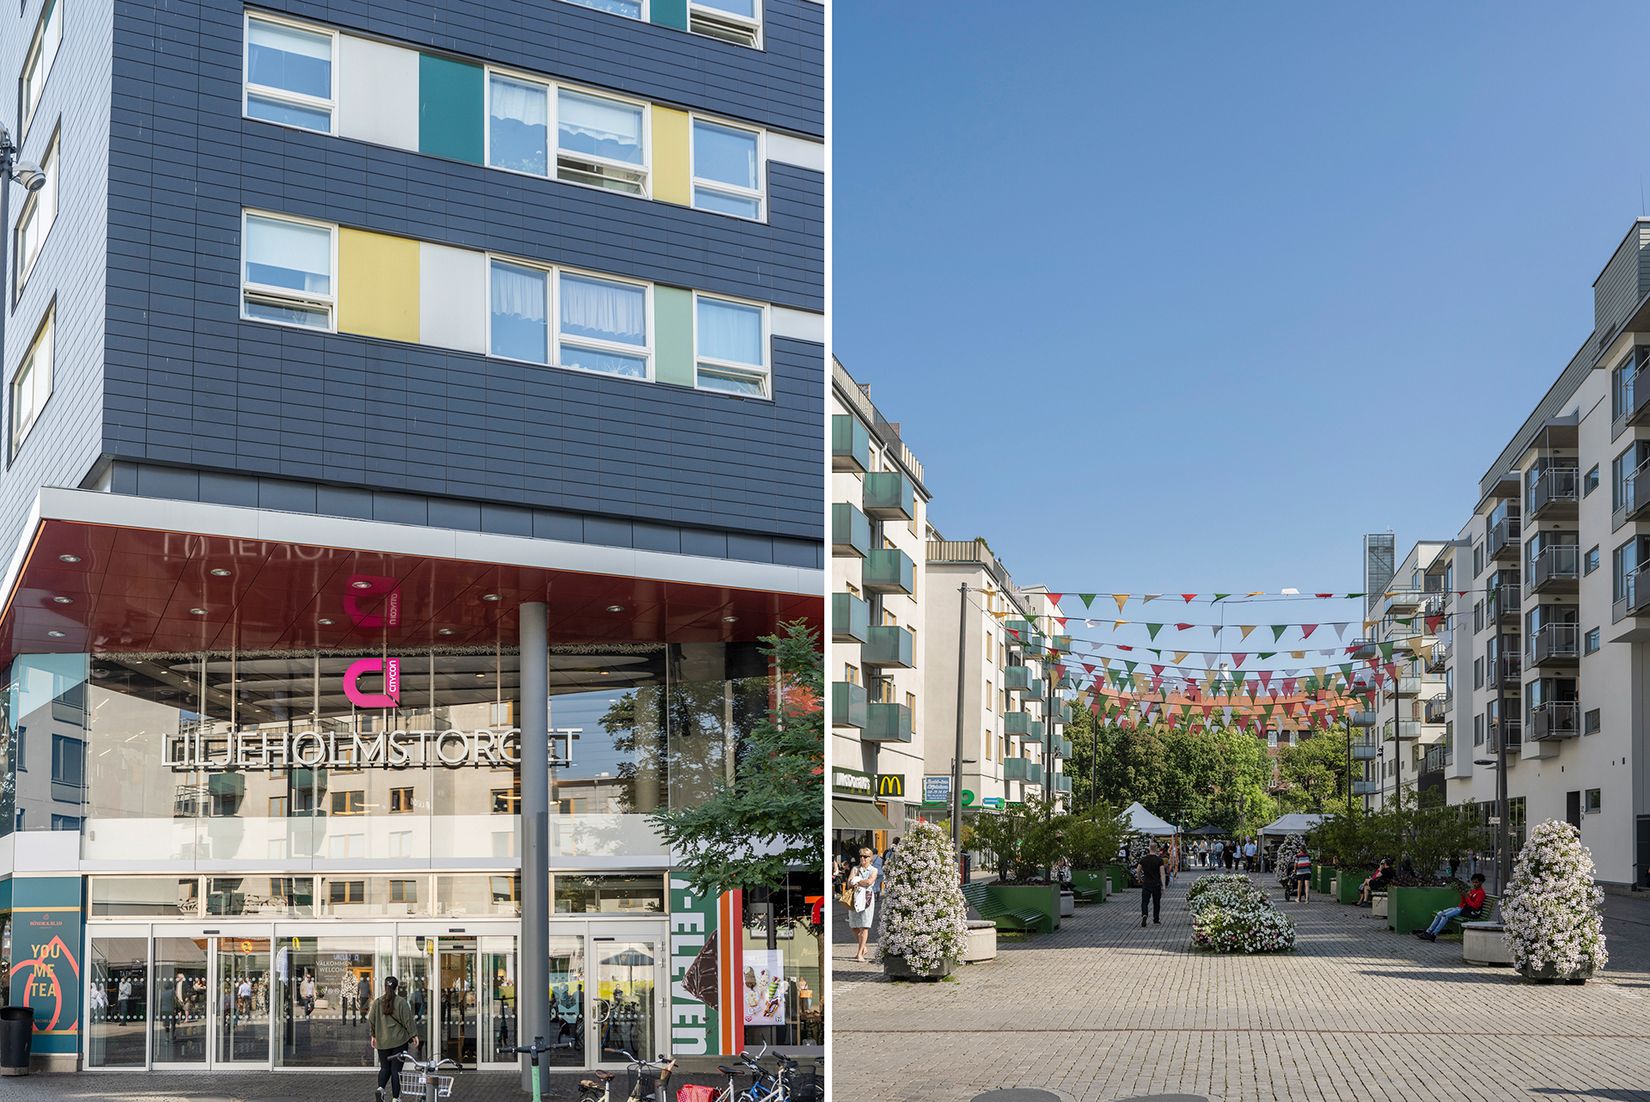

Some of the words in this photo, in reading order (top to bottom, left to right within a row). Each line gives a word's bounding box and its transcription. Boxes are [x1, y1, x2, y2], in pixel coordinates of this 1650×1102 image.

[389, 660, 397, 693] CITYCON
[161, 727, 583, 768] LILJEHOLMSTORGT
[31, 944, 60, 959] YOU
[33, 963, 55, 978] ME
[31, 983, 57, 997] TEA
